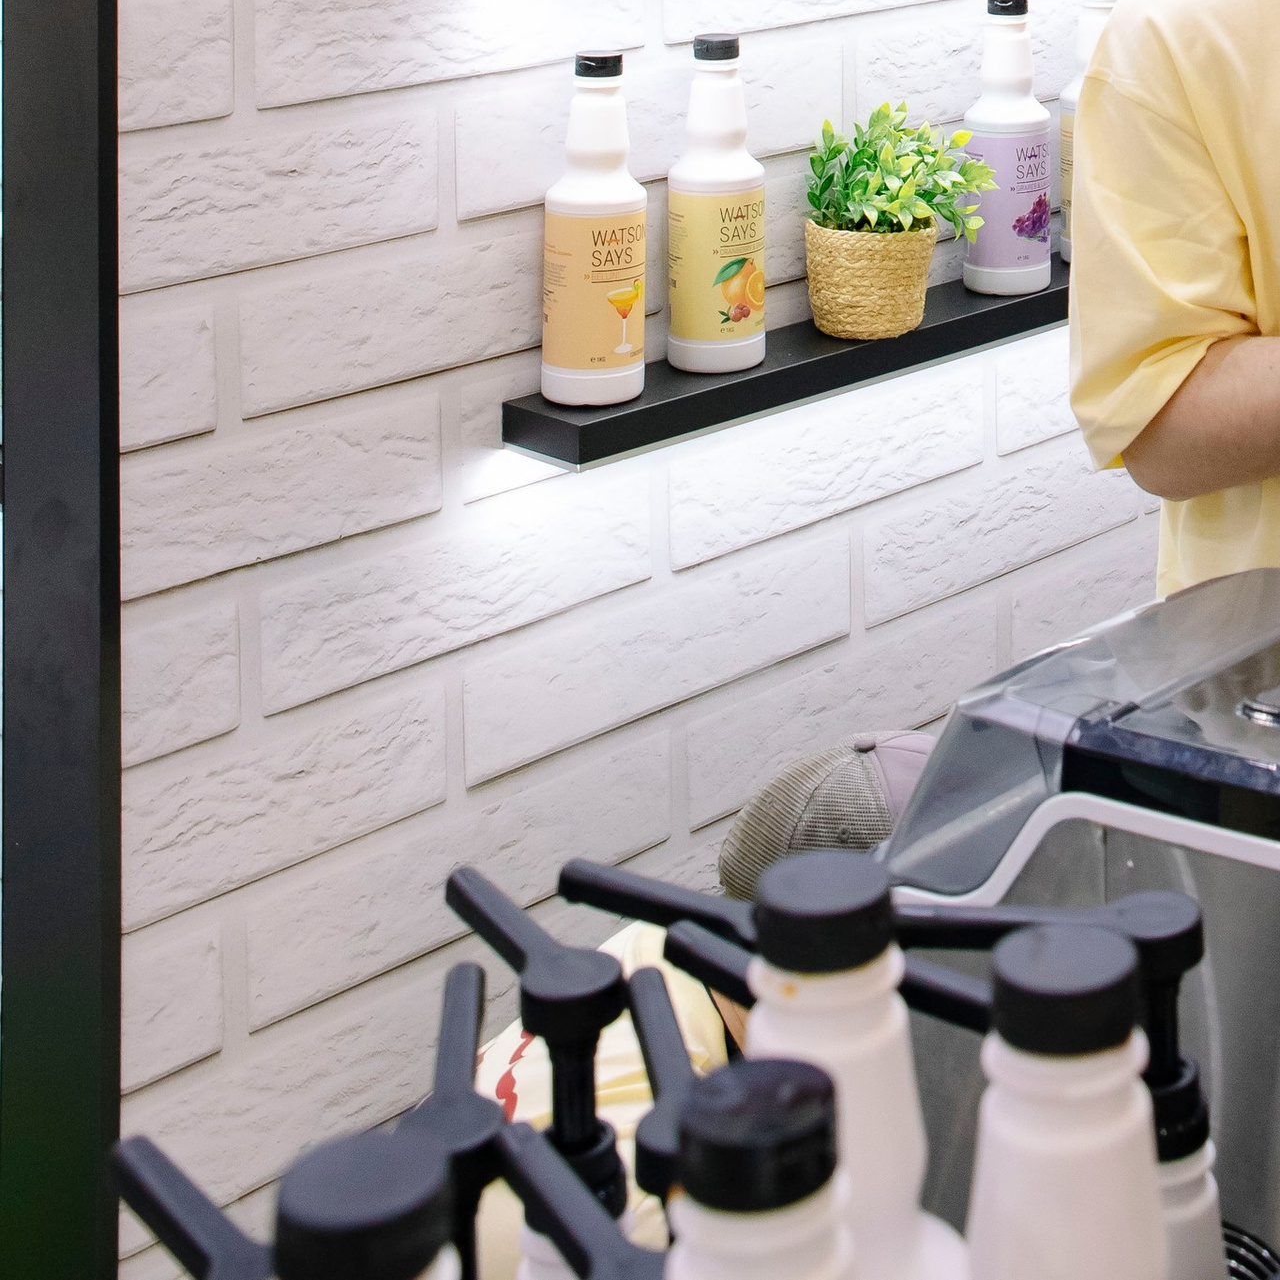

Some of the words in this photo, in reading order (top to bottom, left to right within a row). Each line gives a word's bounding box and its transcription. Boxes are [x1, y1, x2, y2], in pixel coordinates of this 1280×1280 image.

[1016, 143, 1049, 161] WATS
[1016, 161, 1046, 179] SAYS
[720, 200, 764, 223] WATSO
[720, 222, 756, 243] SAYS
[592, 247, 633, 267] SAYS
